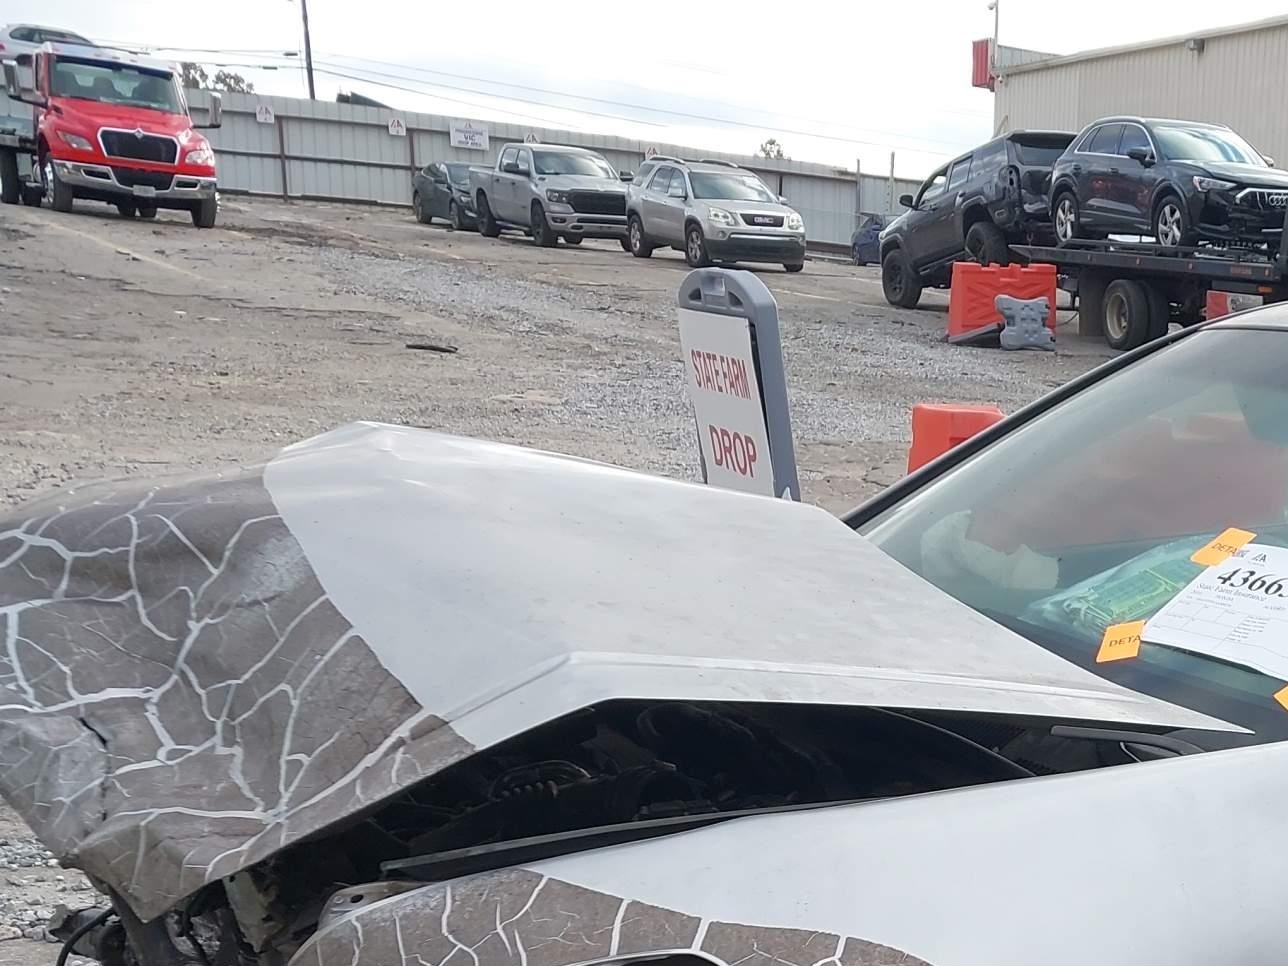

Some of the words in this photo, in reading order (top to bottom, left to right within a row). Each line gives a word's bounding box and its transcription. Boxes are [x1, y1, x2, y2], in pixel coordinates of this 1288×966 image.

[754, 216, 774, 224] GMC
[690, 349, 723, 393] STATE
[720, 357, 752, 400] FARM
[708, 424, 757, 478] DROP
[1109, 634, 1141, 647] DETA
